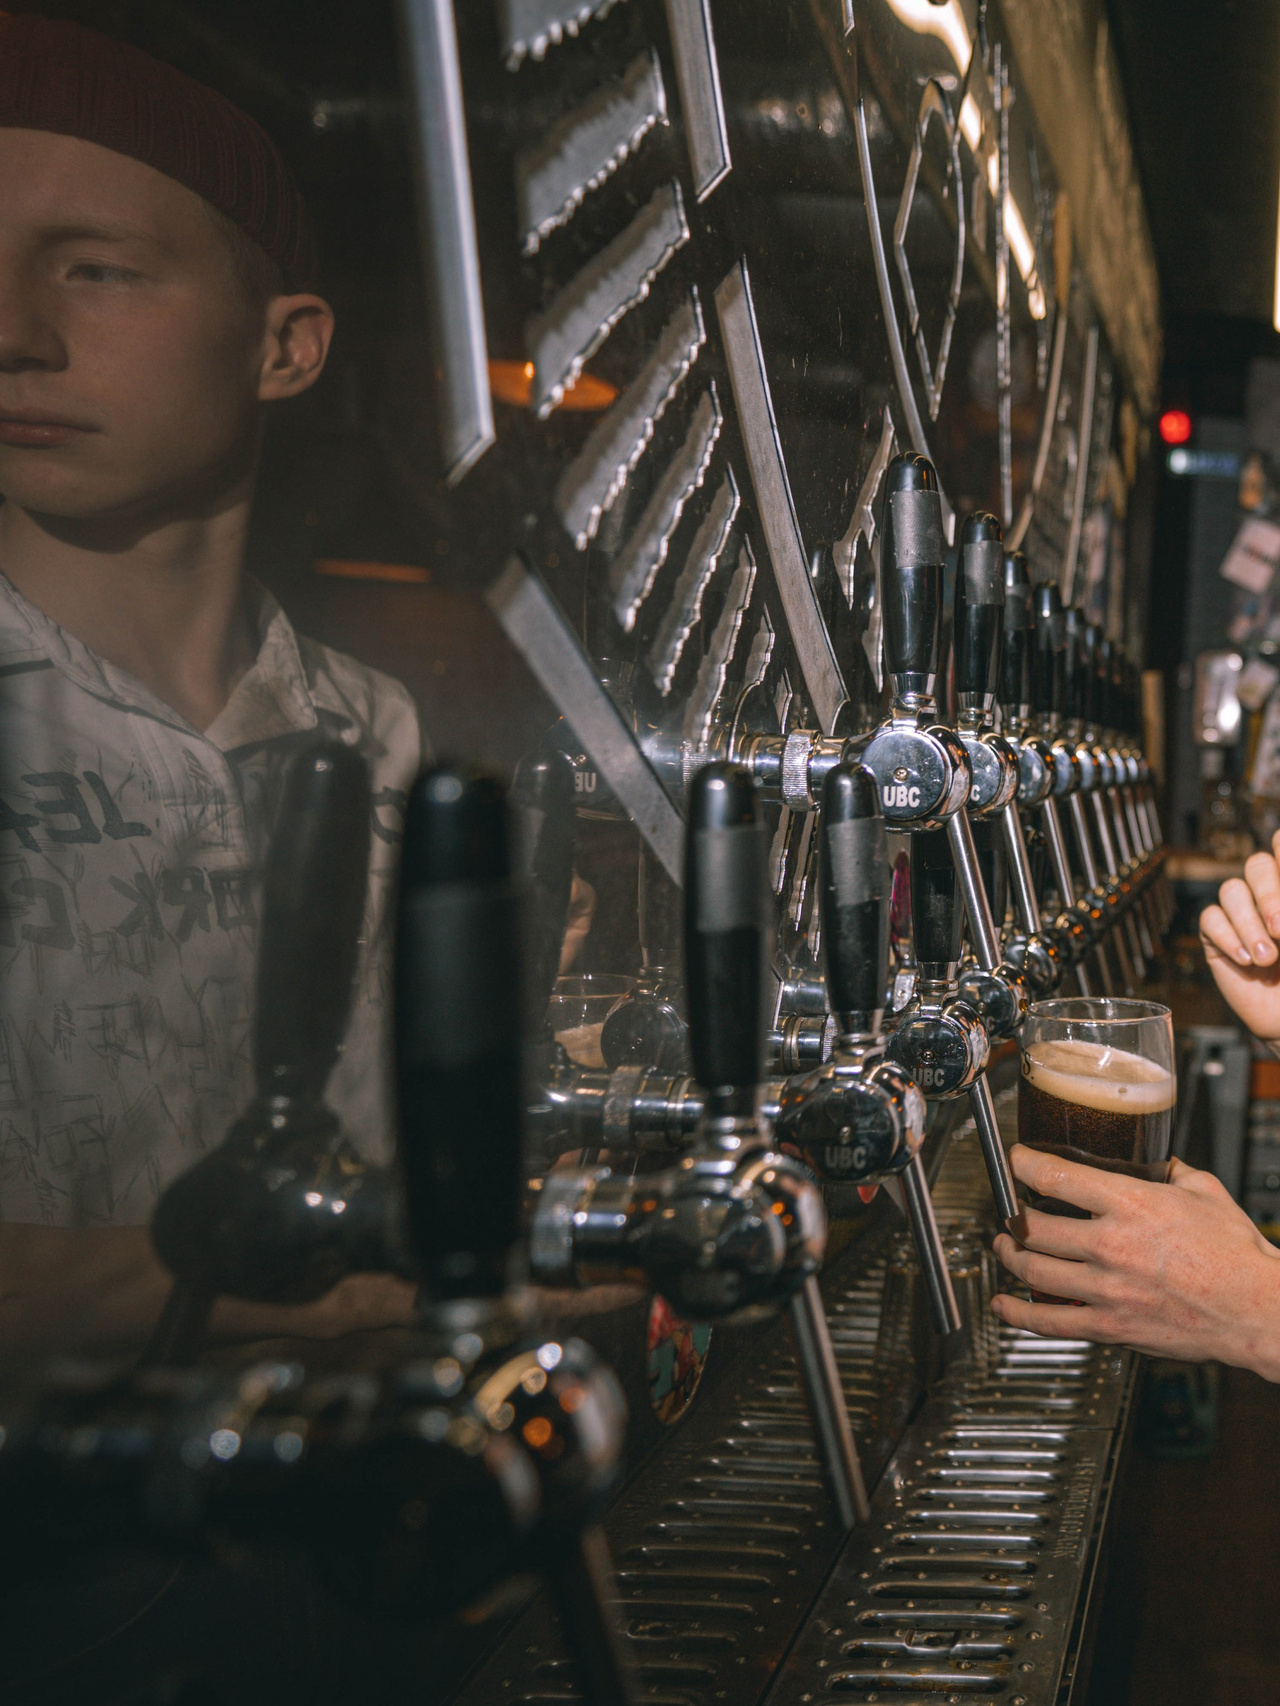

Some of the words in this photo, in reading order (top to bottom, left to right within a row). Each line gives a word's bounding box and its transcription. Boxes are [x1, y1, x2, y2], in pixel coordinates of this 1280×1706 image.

[883, 786, 921, 808] UBC
[912, 1068, 945, 1087] UBC
[825, 1146, 867, 1170] UBC
